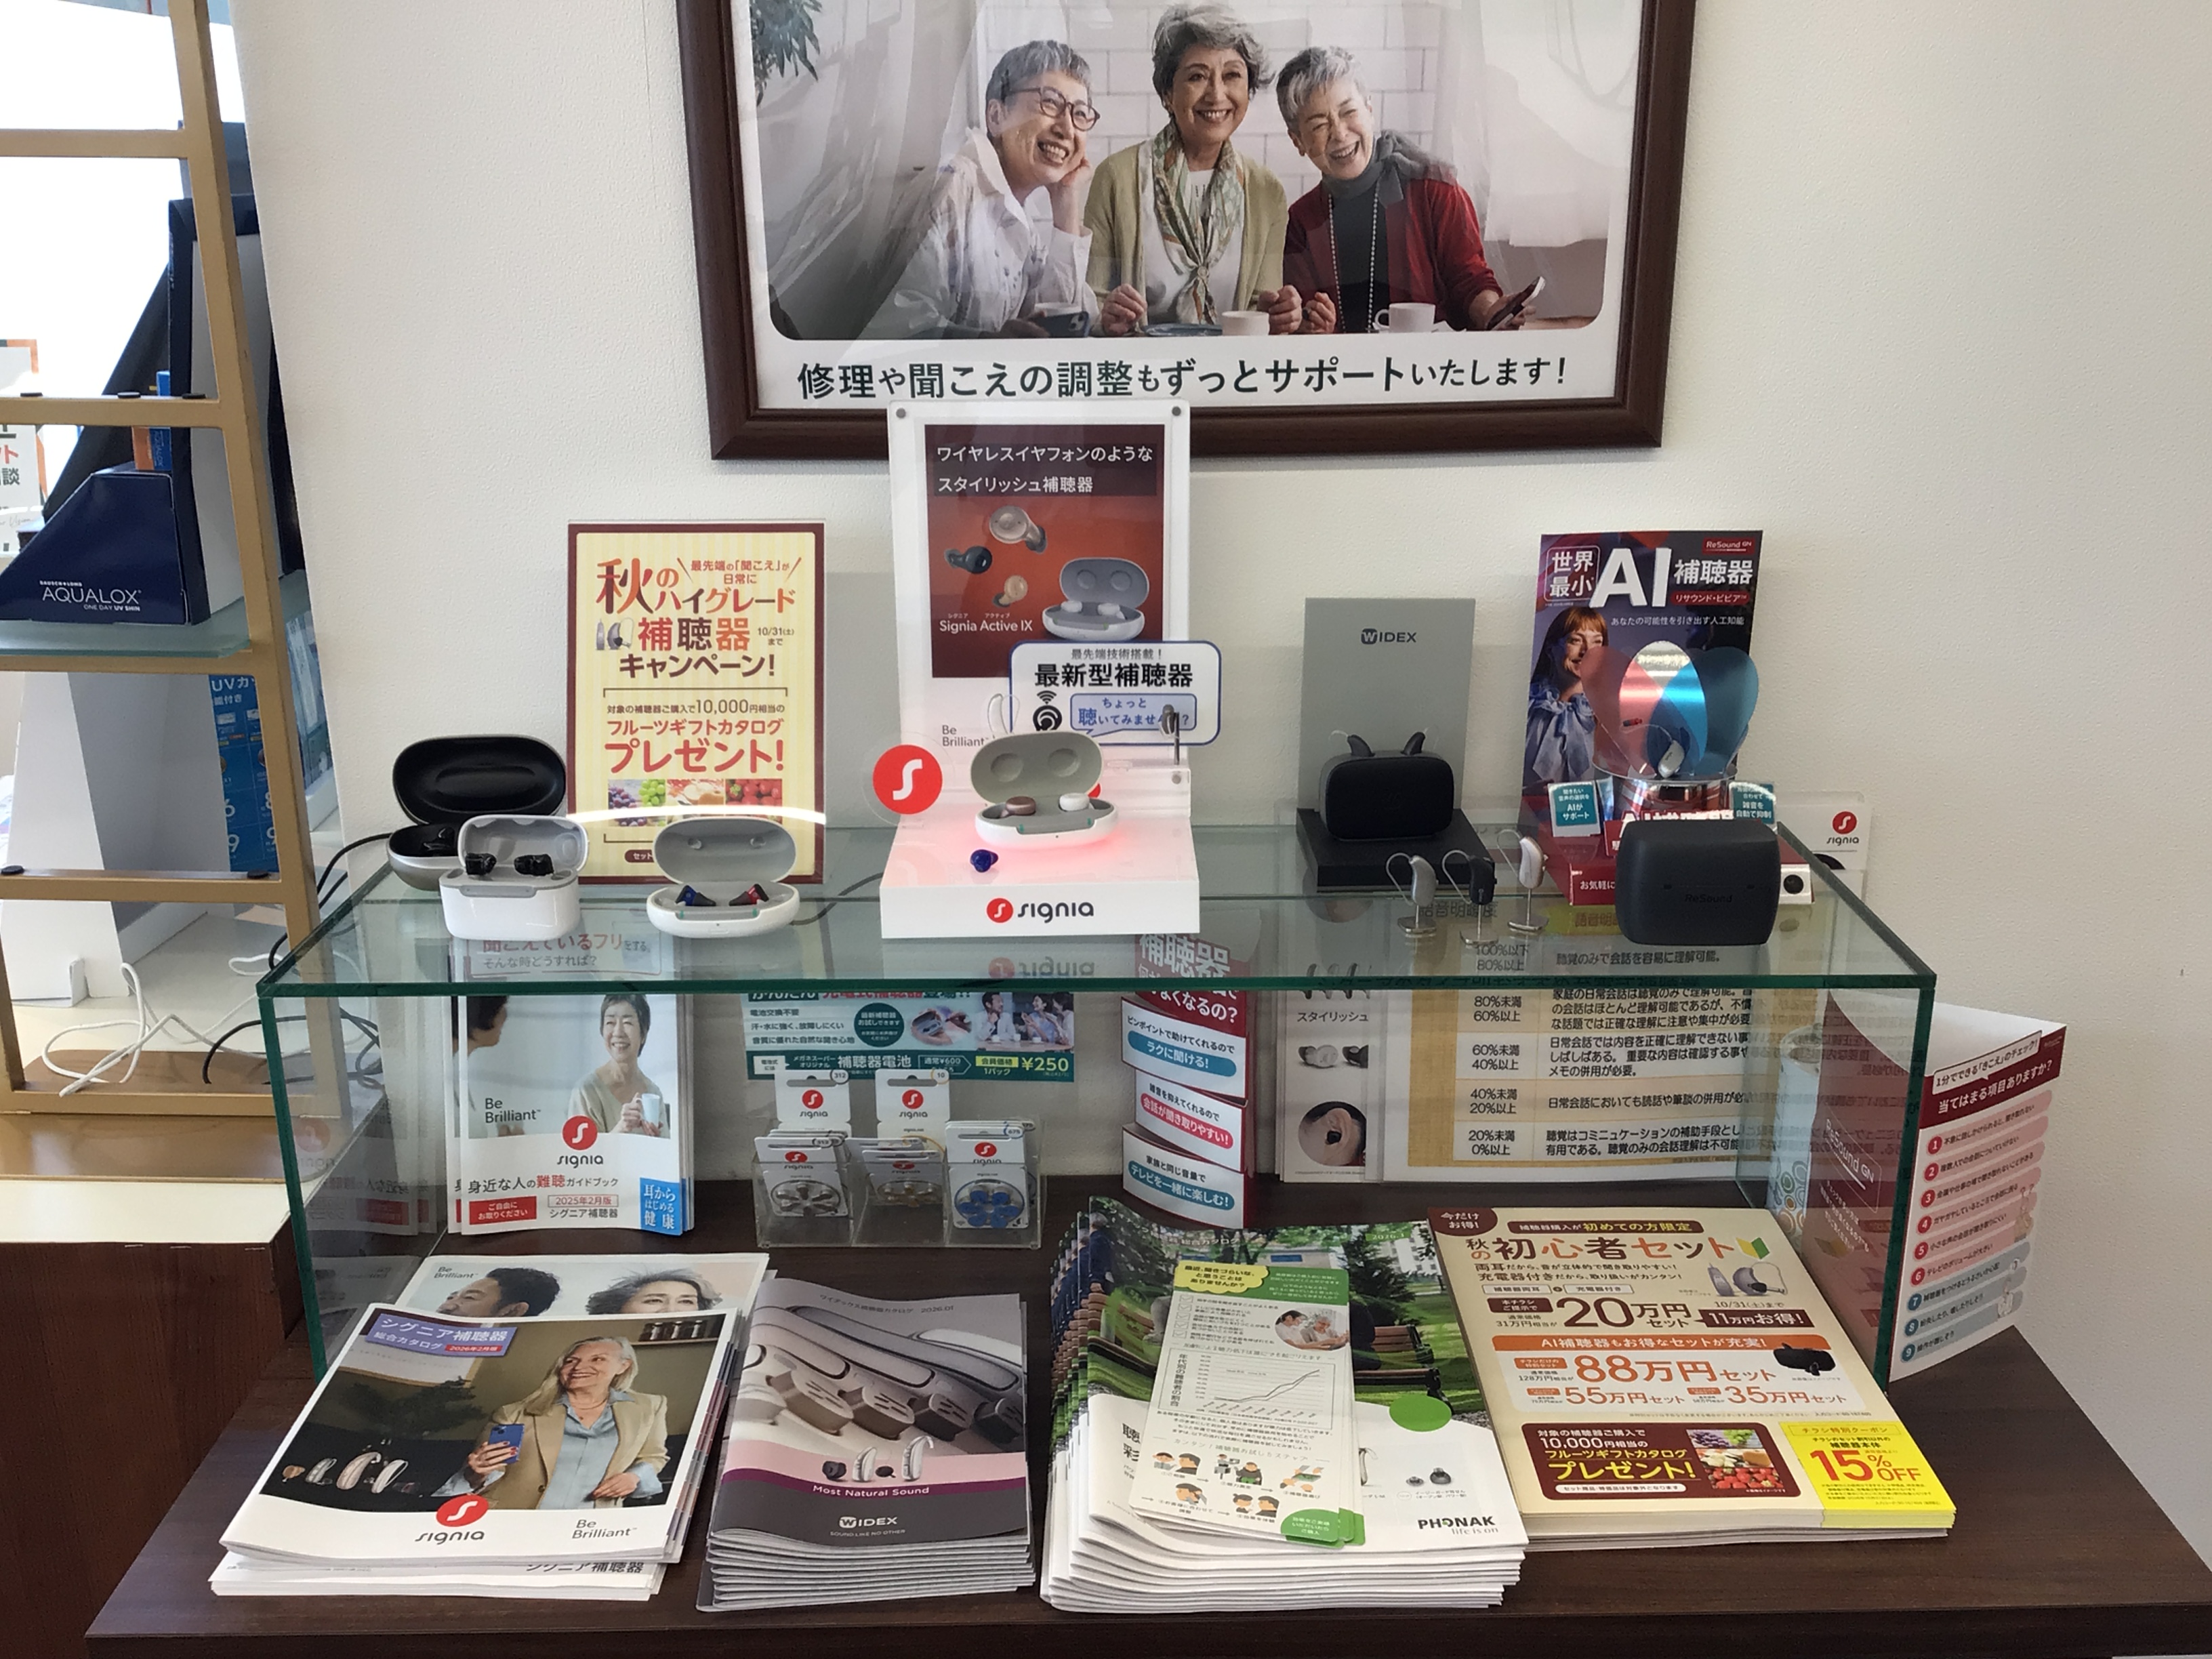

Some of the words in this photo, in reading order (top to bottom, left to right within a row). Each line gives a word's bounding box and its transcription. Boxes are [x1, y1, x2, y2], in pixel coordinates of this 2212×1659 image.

[798, 359, 1567, 400] 修理や聞こえの調整もずっとサポートいたします！
[937, 445, 1153, 462] ワイヤレスイヤフォンのような
[937, 476, 1094, 493] スタイリッシュ補聴器
[1705, 540, 1740, 549] ReSound
[690, 559, 791, 572] 最先端の「聞こえ」が
[1552, 550, 1594, 573] 世界
[722, 572, 758, 586] 日常に
[1589, 547, 1673, 609] AI
[1673, 559, 1754, 585] 補聴器
[596, 558, 680, 615] 秋の
[1549, 575, 1593, 596] 最小
[42, 587, 139, 605] AQUALOX
[654, 588, 796, 613] ハイグレード
[939, 619, 977, 634] Signia
[979, 619, 1019, 632] Active
[1021, 619, 1033, 632] IX
[1611, 615, 1745, 627] あなたの可能性を引き出す人工知能
[638, 617, 751, 651] 補聴器
[766, 636, 784, 646] まで
[1361, 628, 1418, 644] WIDEX
[1071, 648, 1163, 661] 最先端技術搭載！
[619, 653, 776, 679] キャンペーン！
[1034, 663, 1193, 688] 最新型補聴器
[607, 699, 785, 715] 対象の補聴器ご購入で10,000円相当の
[1103, 697, 1147, 710] ちょっと
[608, 718, 785, 736] フルーツギフトカタログ
[942, 724, 957, 735] Be
[604, 737, 785, 774] プレゼント！
[1562, 811, 1590, 821] サポート
[1826, 836, 1860, 846] signia
[1684, 893, 1733, 903] ReSound
[1017, 901, 1094, 924] signia
[483, 955, 597, 969] そんな時どうすれば？
[1556, 949, 1721, 966] 聴覚のみで会話を容易に理解可能。
[1476, 960, 1525, 972] 80%以上
[1474, 996, 1522, 1008] 80%未満
[750, 1008, 800, 1017] 電池交換不要
[1297, 1011, 1370, 1023] スタイリッシュ
[1473, 1010, 1521, 1022] 60%以上
[1551, 1013, 1750, 1031] な話題では正確な理解に注意や集中が必要
[1127, 1015, 1235, 1054] ピンポイントで助けてくれるので
[1145, 1041, 1210, 1069] ラクに聞ける！
[1472, 1044, 1520, 1057] 60%未満
[838, 1055, 912, 1069] 補聴器電池
[981, 1058, 1013, 1066] 会員価格
[1021, 1056, 1069, 1072] ¥250
[1471, 1059, 1519, 1071] 40%以上
[1936, 1039, 2039, 1088] 1分でできる「きこえ」のチェック！
[984, 1067, 1010, 1076] 1パック
[1549, 1064, 1637, 1078] メモの併用が必要。
[1938, 1059, 2053, 1115] 当てはまる項目ありますか？
[1470, 1088, 1517, 1101] 40%未満
[484, 1098, 503, 1110] Be
[1469, 1103, 1517, 1115] 20%以上
[799, 1111, 828, 1119] signia
[899, 1111, 928, 1120] signia
[1142, 1097, 1229, 1147] 会話が聞き取りやすい！
[1468, 1130, 1515, 1142] 20%未満
[1471, 1144, 1511, 1156] 0%以上
[557, 1154, 604, 1169] signia
[1146, 1155, 1206, 1183] 家族と同じ音量で
[468, 1174, 619, 1195] 身近な人の難聴ガイドブック
[1130, 1164, 1229, 1208] テレビを一緒に楽しむ！
[555, 1195, 612, 1206] 2025年2月版
[643, 1185, 676, 1202] 耳から
[487, 1202, 518, 1212] ご自由に
[550, 1208, 619, 1218] シグニア補聴器
[644, 1200, 675, 1213] はじめる
[478, 1208, 529, 1221] お取りください
[643, 1212, 675, 1231] 健康
[1441, 1212, 1479, 1221] 今だけ
[1448, 1221, 1479, 1229] お得！
[1519, 1222, 1693, 1232] 補聴器購入が初めての方限定
[1492, 1236, 1735, 1261] 初心者セット
[1190, 1278, 1246, 1288] ありませんか？
[1556, 1297, 1692, 1328] 20万円
[1708, 1311, 1803, 1326] 11万円お得！
[380, 1317, 508, 1343] シグニア補聴器
[1645, 1319, 1689, 1328] セット
[373, 1331, 443, 1351] 総合カタログ
[1540, 1335, 1767, 1350] AI補聴器もお得なセットが充実！
[1574, 1354, 1718, 1383] 88万円
[1719, 1369, 1777, 1382] セット
[1565, 1387, 1649, 1405] 55万円
[1650, 1395, 1685, 1404] セット
[1725, 1386, 1811, 1404] 35万円
[1811, 1395, 1847, 1404] セット
[1537, 1429, 1646, 1437] 対象の補聴器ご購入で
[1540, 1437, 1648, 1449] 10,000円相当の
[1544, 1448, 1689, 1458] フルーツギフトカタログ
[1548, 1460, 1696, 1480] プレゼント！
[1877, 1467, 1921, 1481] OFF
[813, 1484, 841, 1496] Most
[844, 1487, 888, 1498] Natural
[893, 1486, 930, 1496] Sound
[576, 1518, 598, 1530] Be
[839, 1515, 899, 1529] WIDEX
[1418, 1515, 1496, 1530] PHONAK
[415, 1530, 485, 1546] signia
[1451, 1528, 1471, 1536] life
[1473, 1527, 1483, 1535] is
